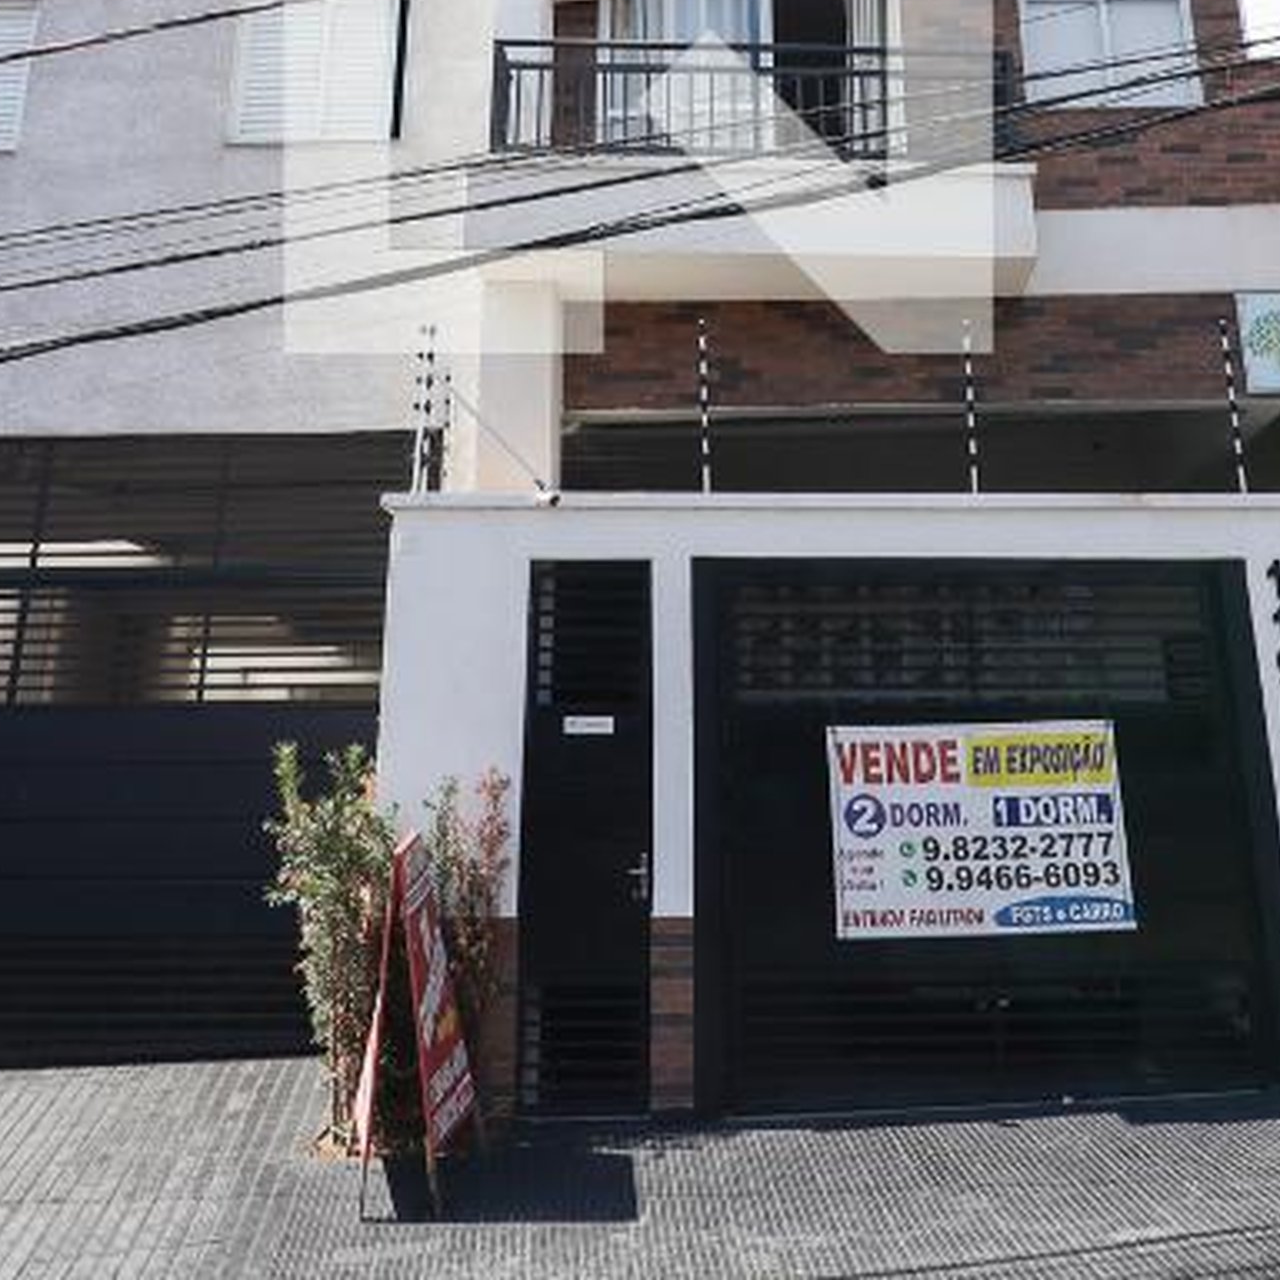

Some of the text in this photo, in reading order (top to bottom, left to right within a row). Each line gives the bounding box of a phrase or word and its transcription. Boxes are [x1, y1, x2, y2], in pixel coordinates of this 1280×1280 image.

[835, 740, 961, 784] VENDE
[972, 736, 1105, 783] EM EXPOSIÇÃO
[890, 803, 968, 827] DORM.
[996, 796, 1109, 827] 1 DORM.
[923, 832, 1114, 862] 9.8232-2777
[926, 862, 1121, 892] 9.9466-6093
